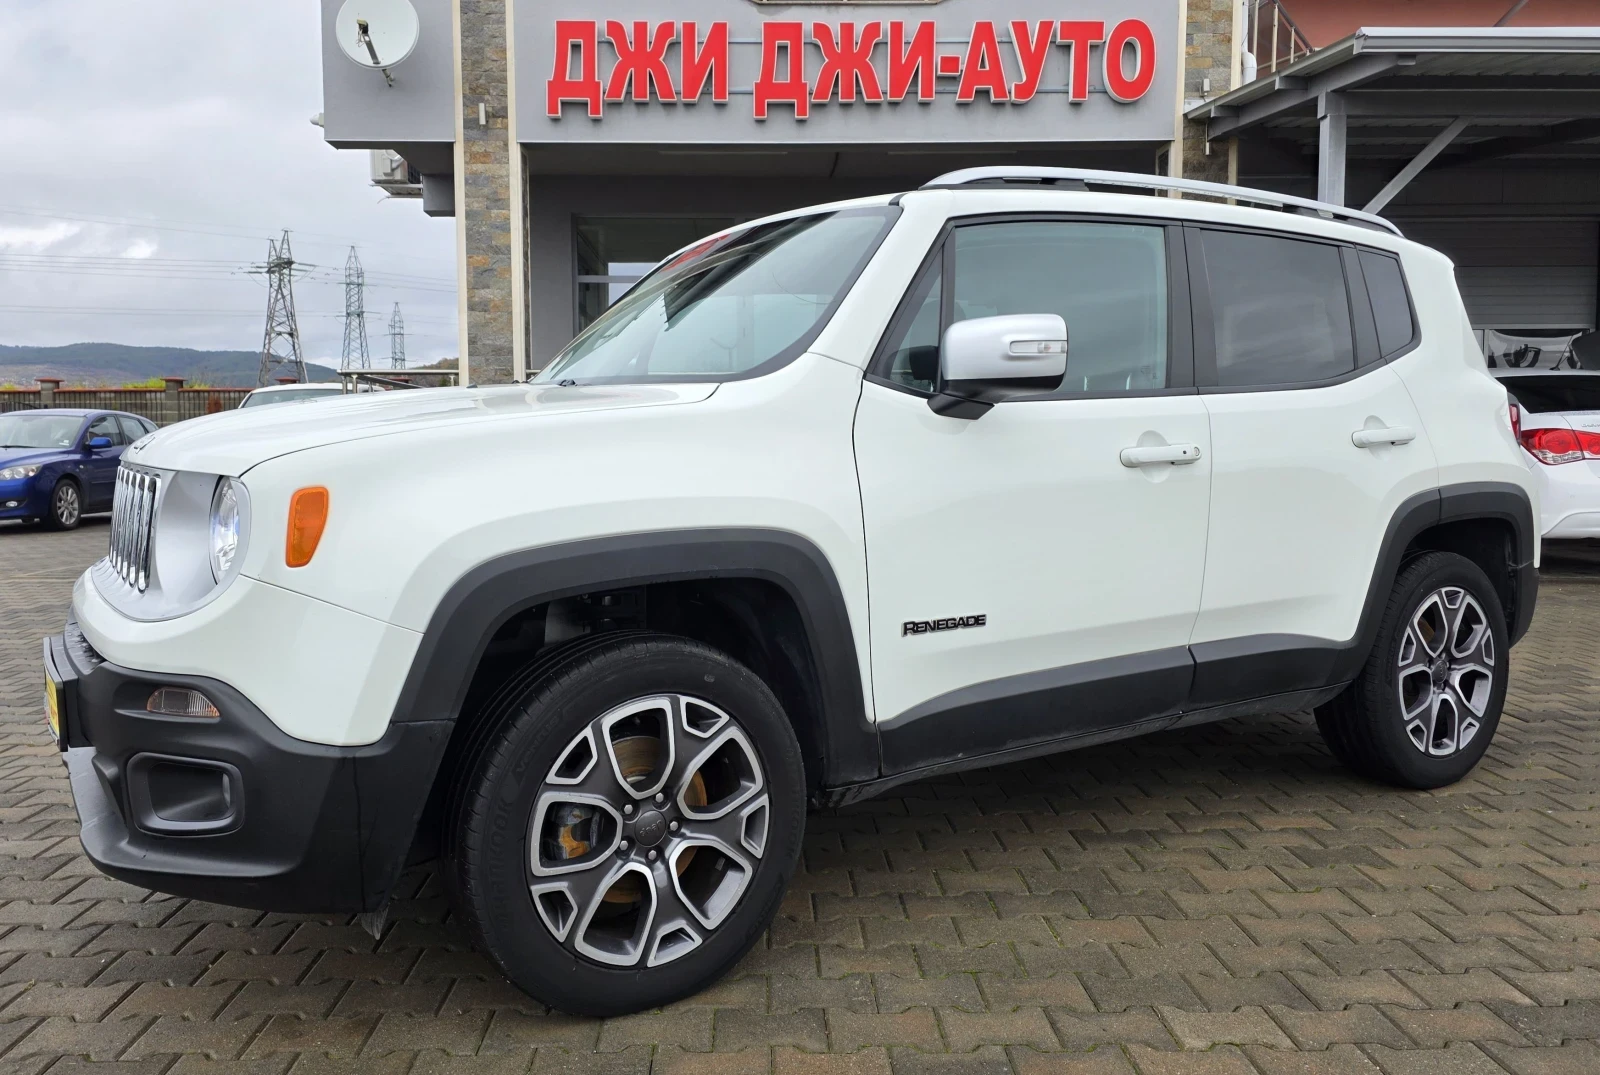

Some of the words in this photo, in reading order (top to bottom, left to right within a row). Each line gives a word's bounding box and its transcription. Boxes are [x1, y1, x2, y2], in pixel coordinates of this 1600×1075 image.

[546, 19, 729, 120] ДЖИ
[752, 17, 1158, 121] ДЖИ-АУТО
[901, 614, 986, 637] RENEGADE
